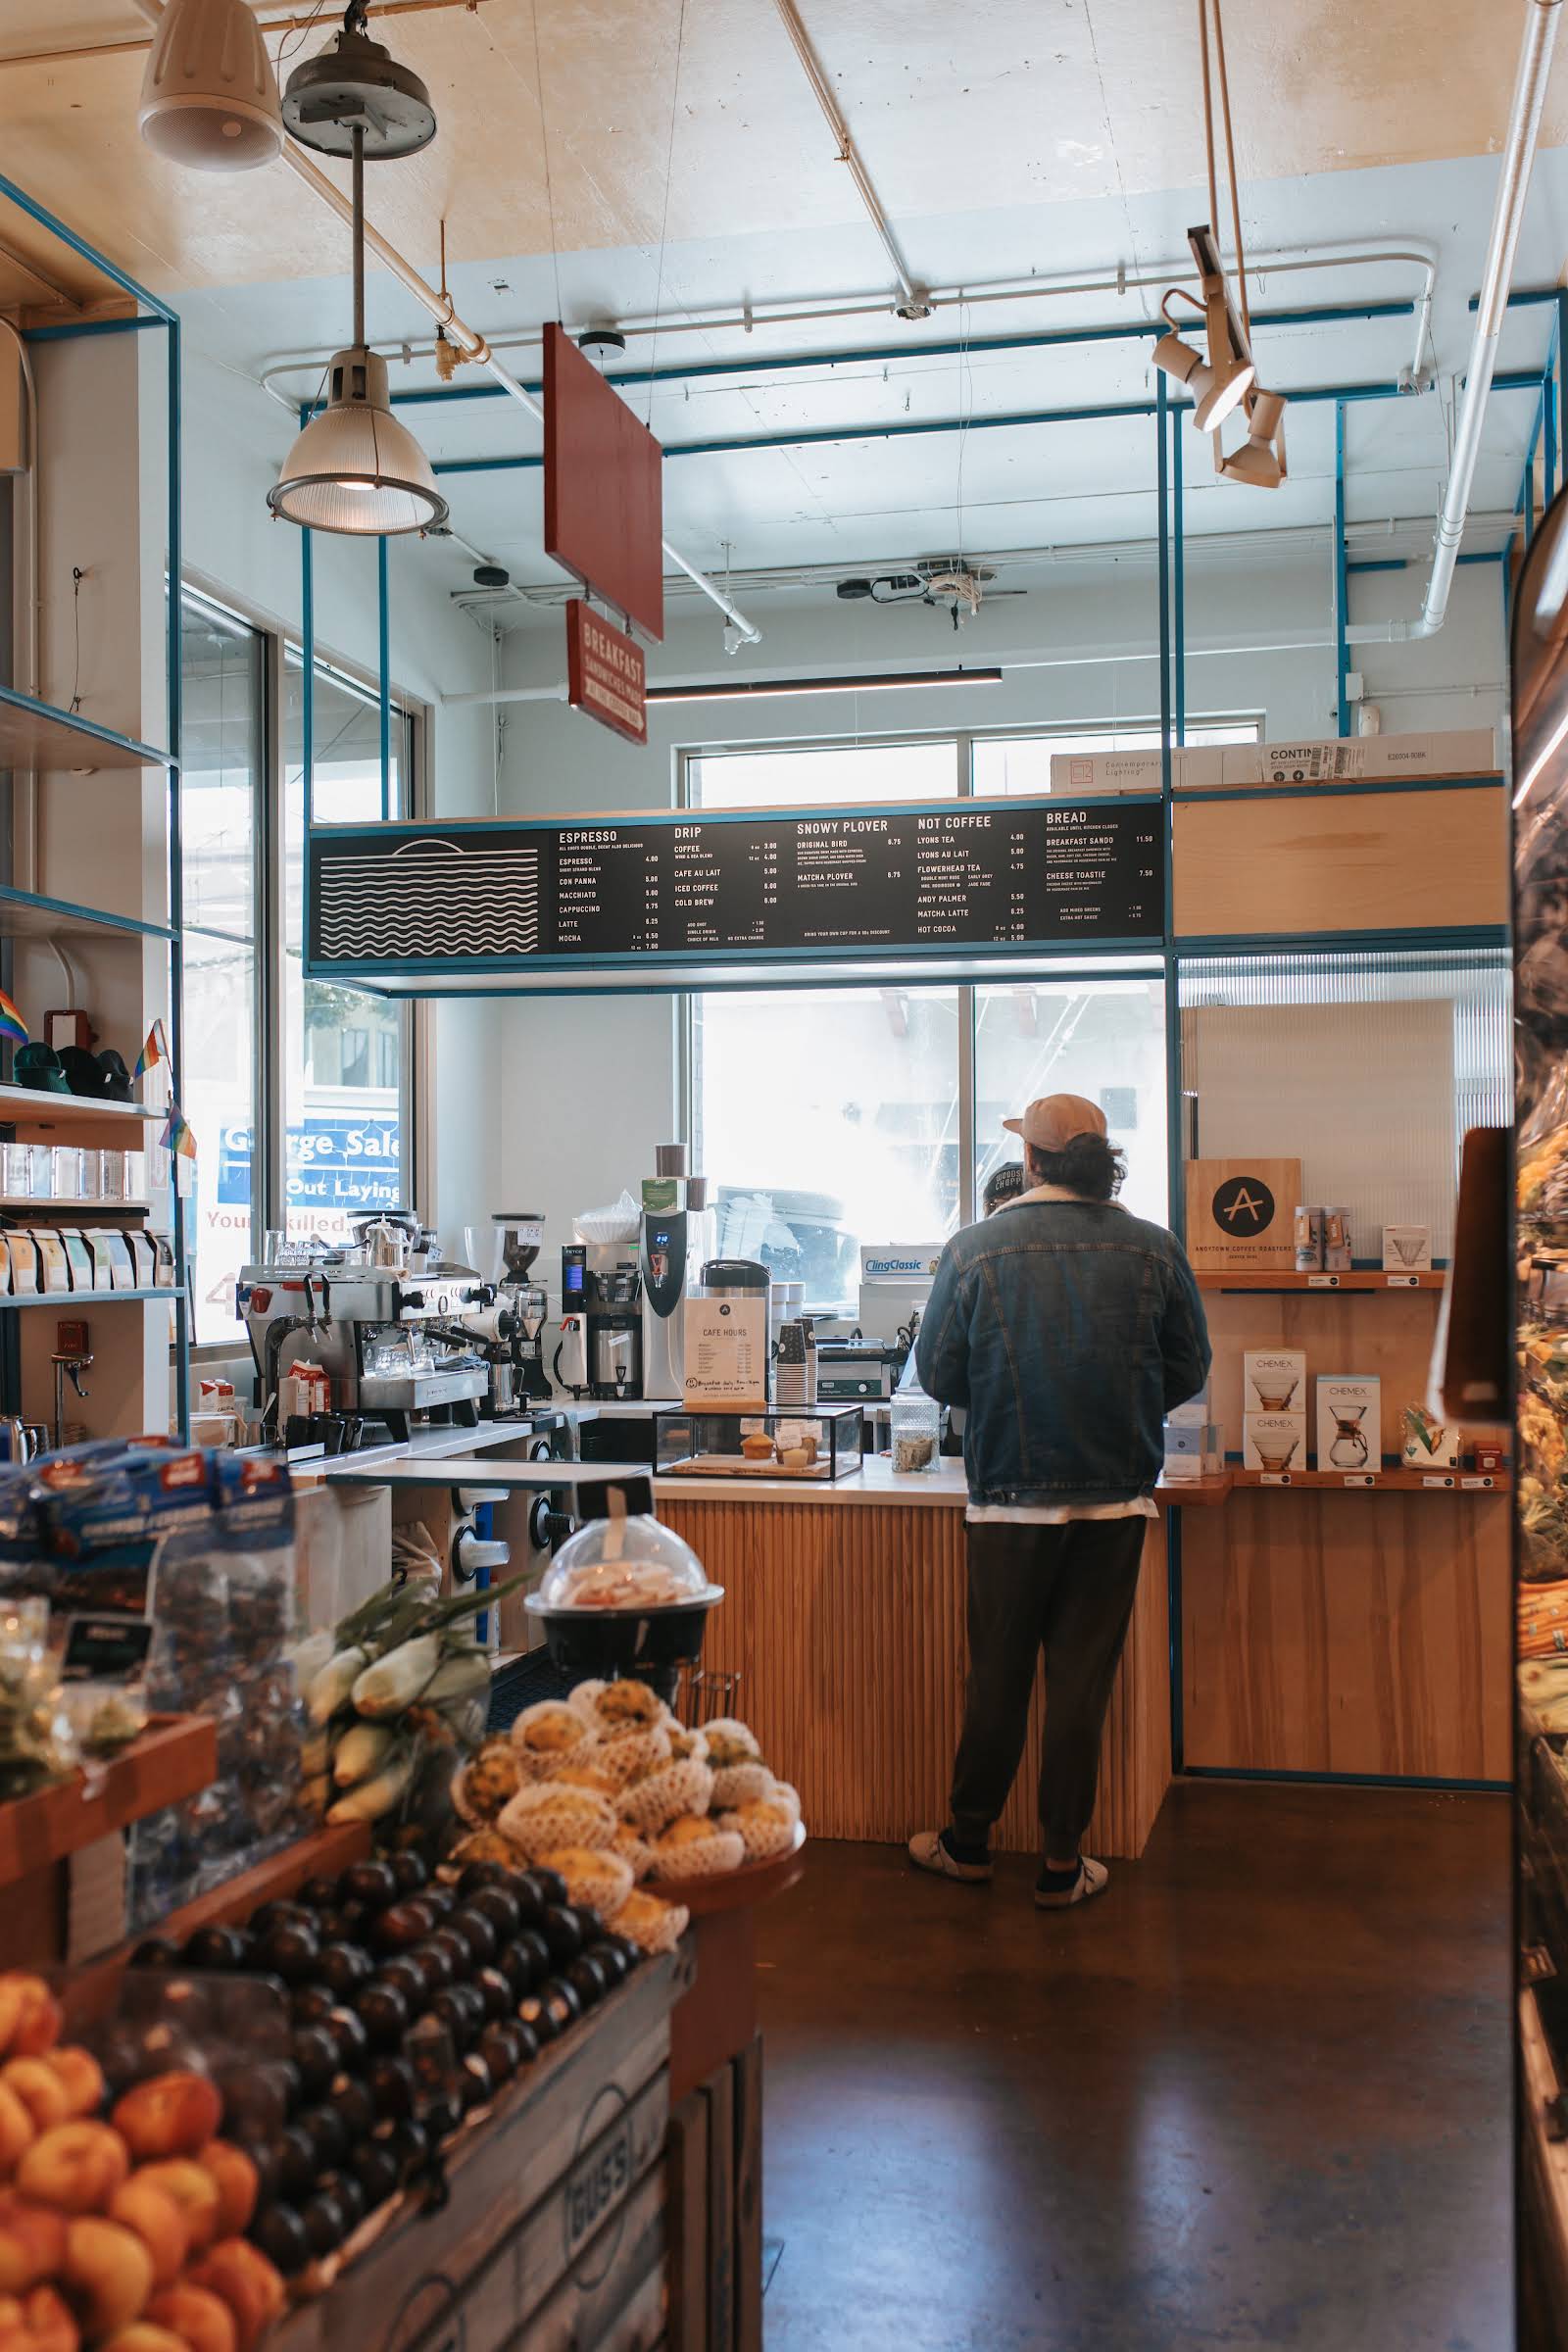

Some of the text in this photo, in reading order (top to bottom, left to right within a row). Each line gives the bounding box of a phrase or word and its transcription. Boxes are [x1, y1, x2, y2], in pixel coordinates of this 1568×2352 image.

[584, 621, 642, 686] BREAKFAST
[918, 816, 992, 830] NOT COFFEE
[1047, 811, 1087, 824] BREAD
[674, 827, 702, 839] DRIP
[797, 820, 888, 835] SNOWY PLOVER
[559, 831, 617, 844] ESPRESSO
[917, 836, 939, 845] LYONS
[1046, 838, 1088, 847] BREAKFAST
[917, 864, 965, 873] FLOWERHEAD
[559, 891, 597, 900] MACCHIATO
[286, 1178, 327, 1196] Out
[207, 1211, 351, 1236] You killed,
[866, 1259, 922, 1272] ClingClassic
[1256, 1359, 1293, 1368] CHEMEX
[1257, 1419, 1294, 1428] CHEMEX
